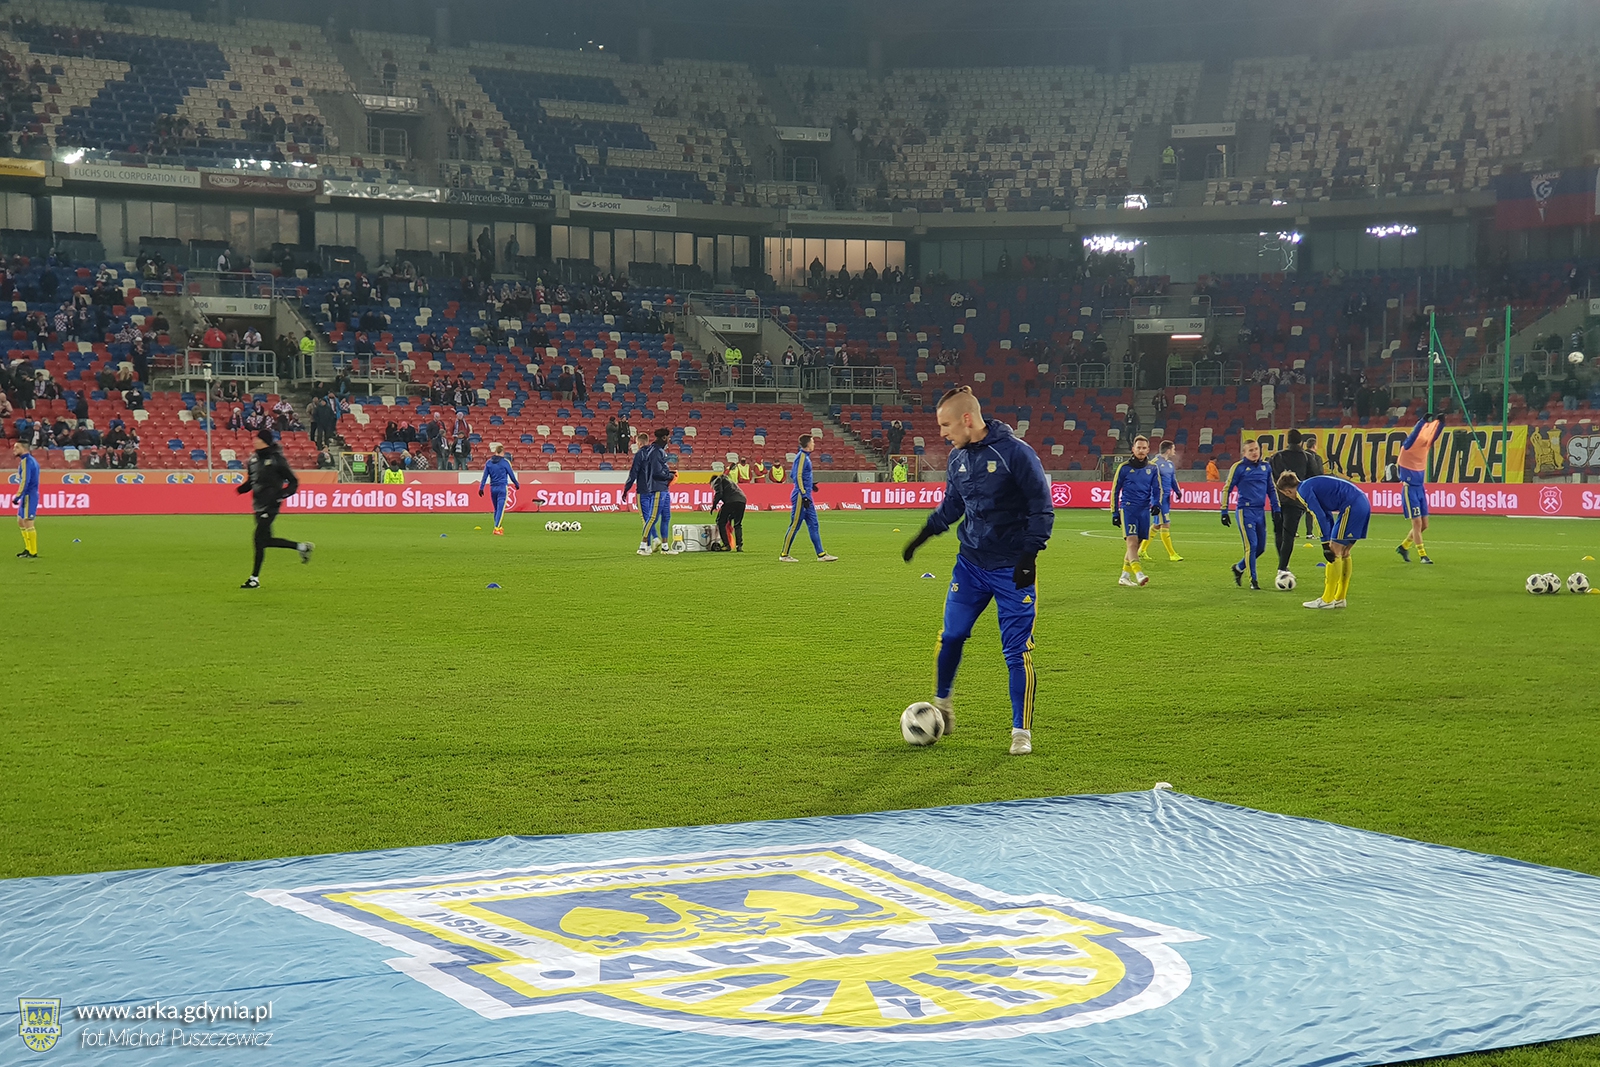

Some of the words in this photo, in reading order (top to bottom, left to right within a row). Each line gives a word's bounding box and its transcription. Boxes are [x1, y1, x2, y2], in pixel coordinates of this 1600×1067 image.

[74, 168, 101, 177] FUCHS
[103, 169, 116, 178] OIL
[119, 171, 176, 182] CORPORATION
[179, 175, 196, 184] (PL)
[461, 191, 525, 205] Mercedes-Benz
[592, 201, 621, 209] S-SPORT
[286, 489, 328, 509] bije
[332, 489, 397, 508] źródło
[402, 487, 469, 510] Śląska
[536, 489, 612, 506] Sztolnia
[861, 488, 882, 504] Tu
[885, 488, 916, 505] bije
[1372, 489, 1402, 509] bije
[1460, 487, 1518, 511] Śląska
[591, 503, 620, 512] Henryk
[1412, 506, 1421, 516] 23
[1128, 523, 1137, 534] 22
[684, 860, 794, 876] KLUB
[417, 911, 538, 947] MORSKI
[599, 922, 1041, 982] ARKA
